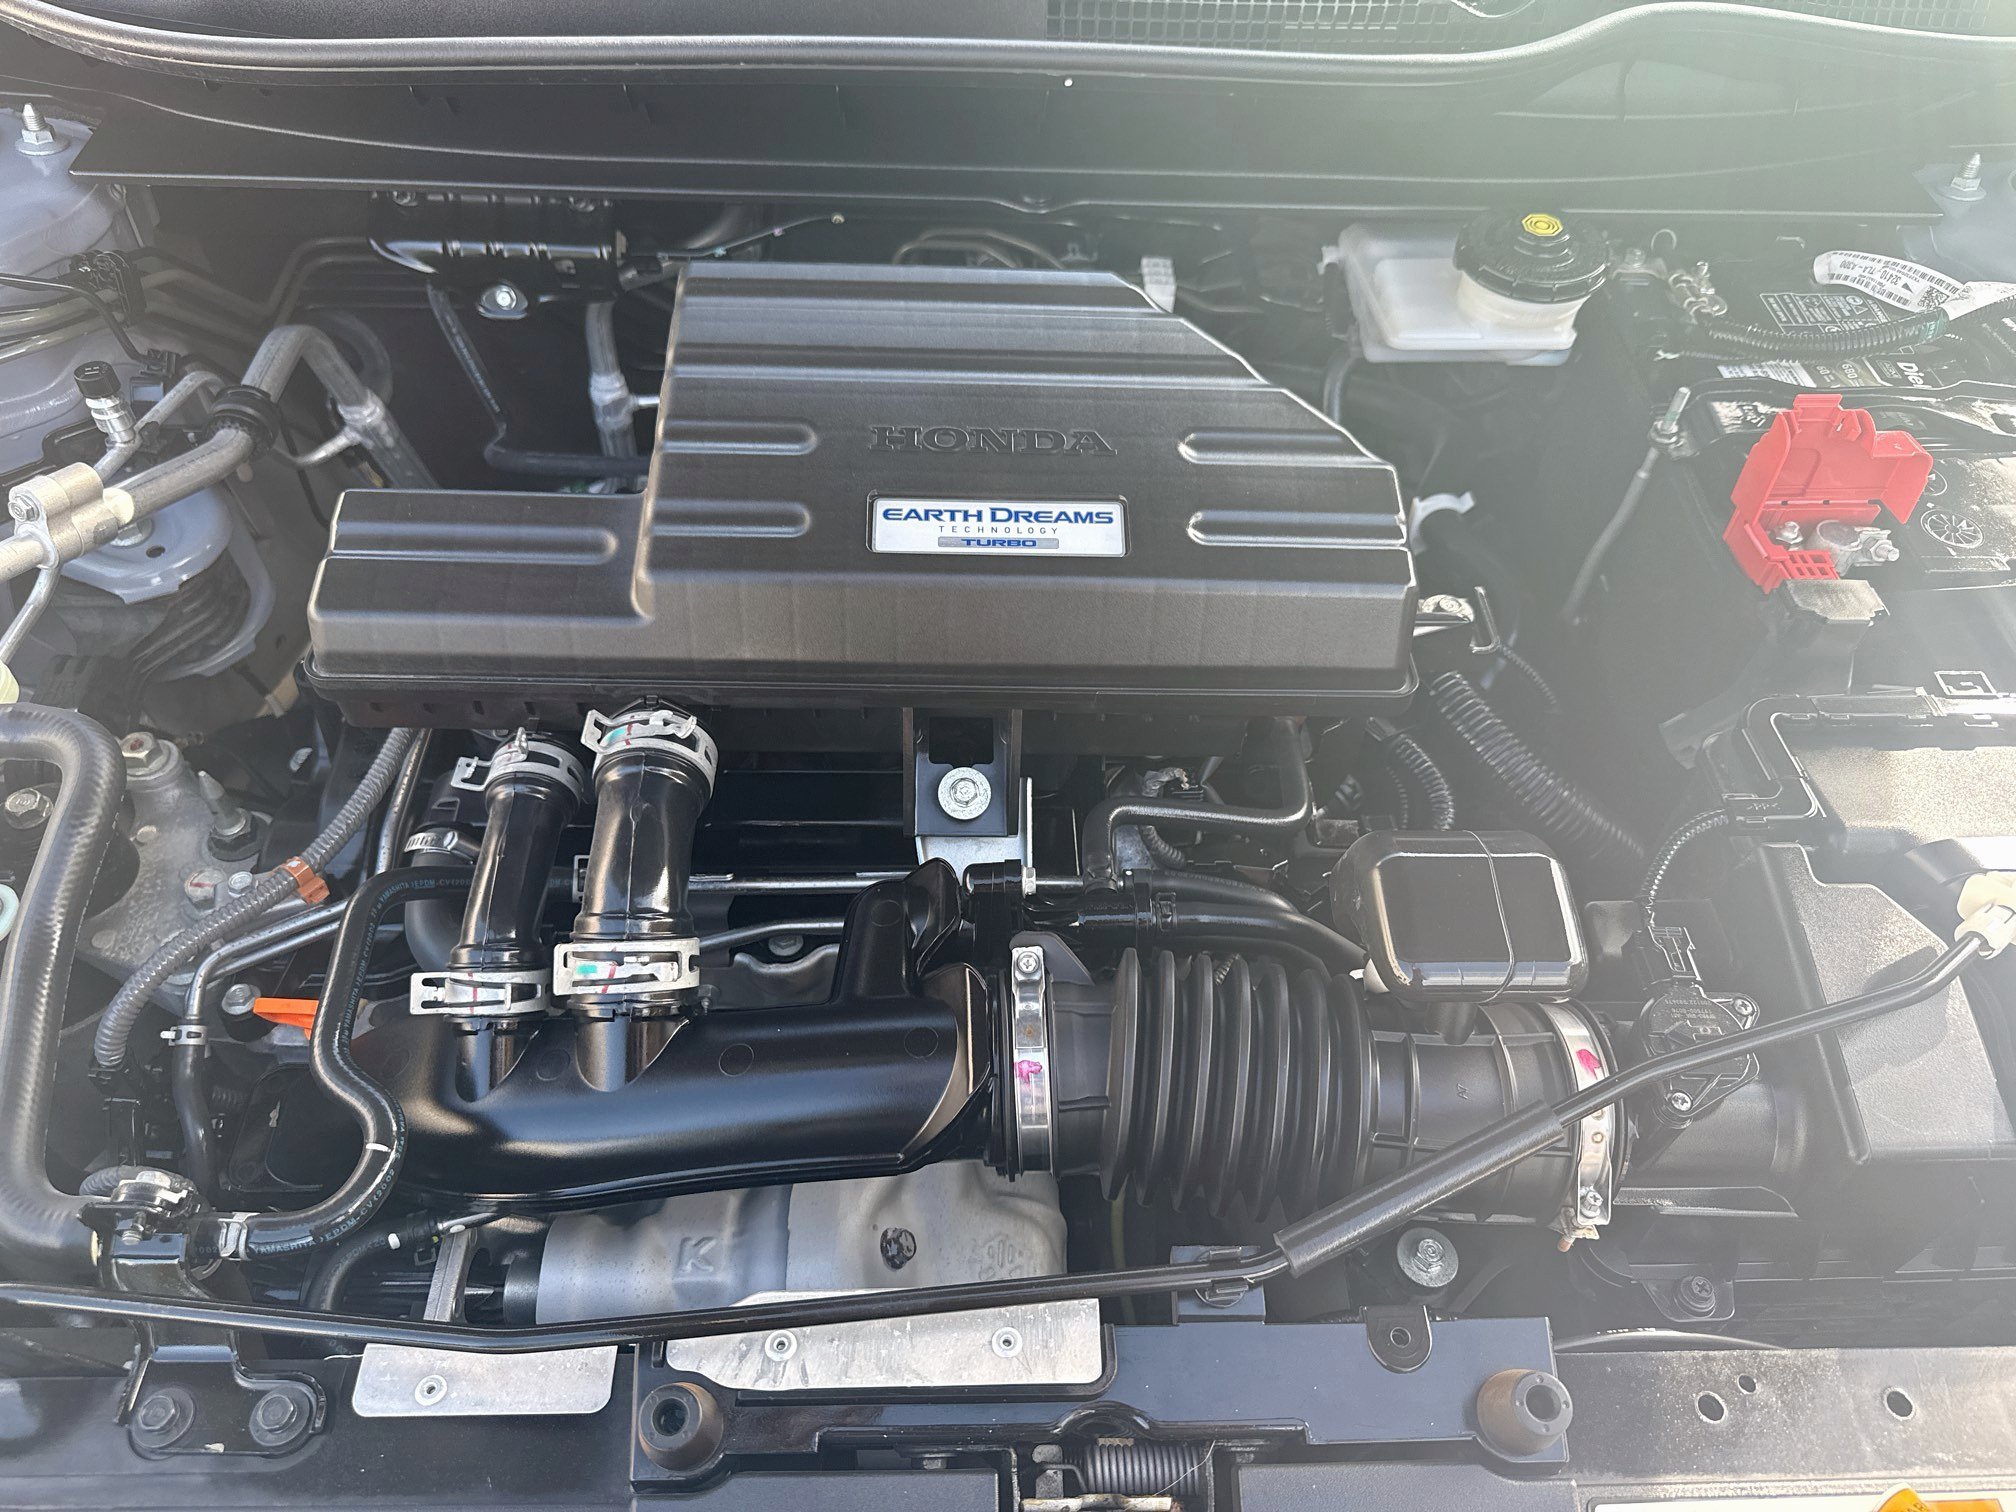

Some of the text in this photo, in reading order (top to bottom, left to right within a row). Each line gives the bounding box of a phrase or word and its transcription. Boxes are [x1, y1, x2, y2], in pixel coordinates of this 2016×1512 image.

[1841, 363, 1858, 379] 680
[869, 425, 1118, 455] HONDA
[882, 507, 1114, 524] EARTH DREAMS
[939, 525, 1059, 535] TECHNOLOGY
[960, 538, 1037, 547] TURBO
[379, 881, 410, 902] YAMASHITA
[344, 987, 359, 1026] YAMASHITA
[253, 1240, 316, 1255] YAMASHITA
